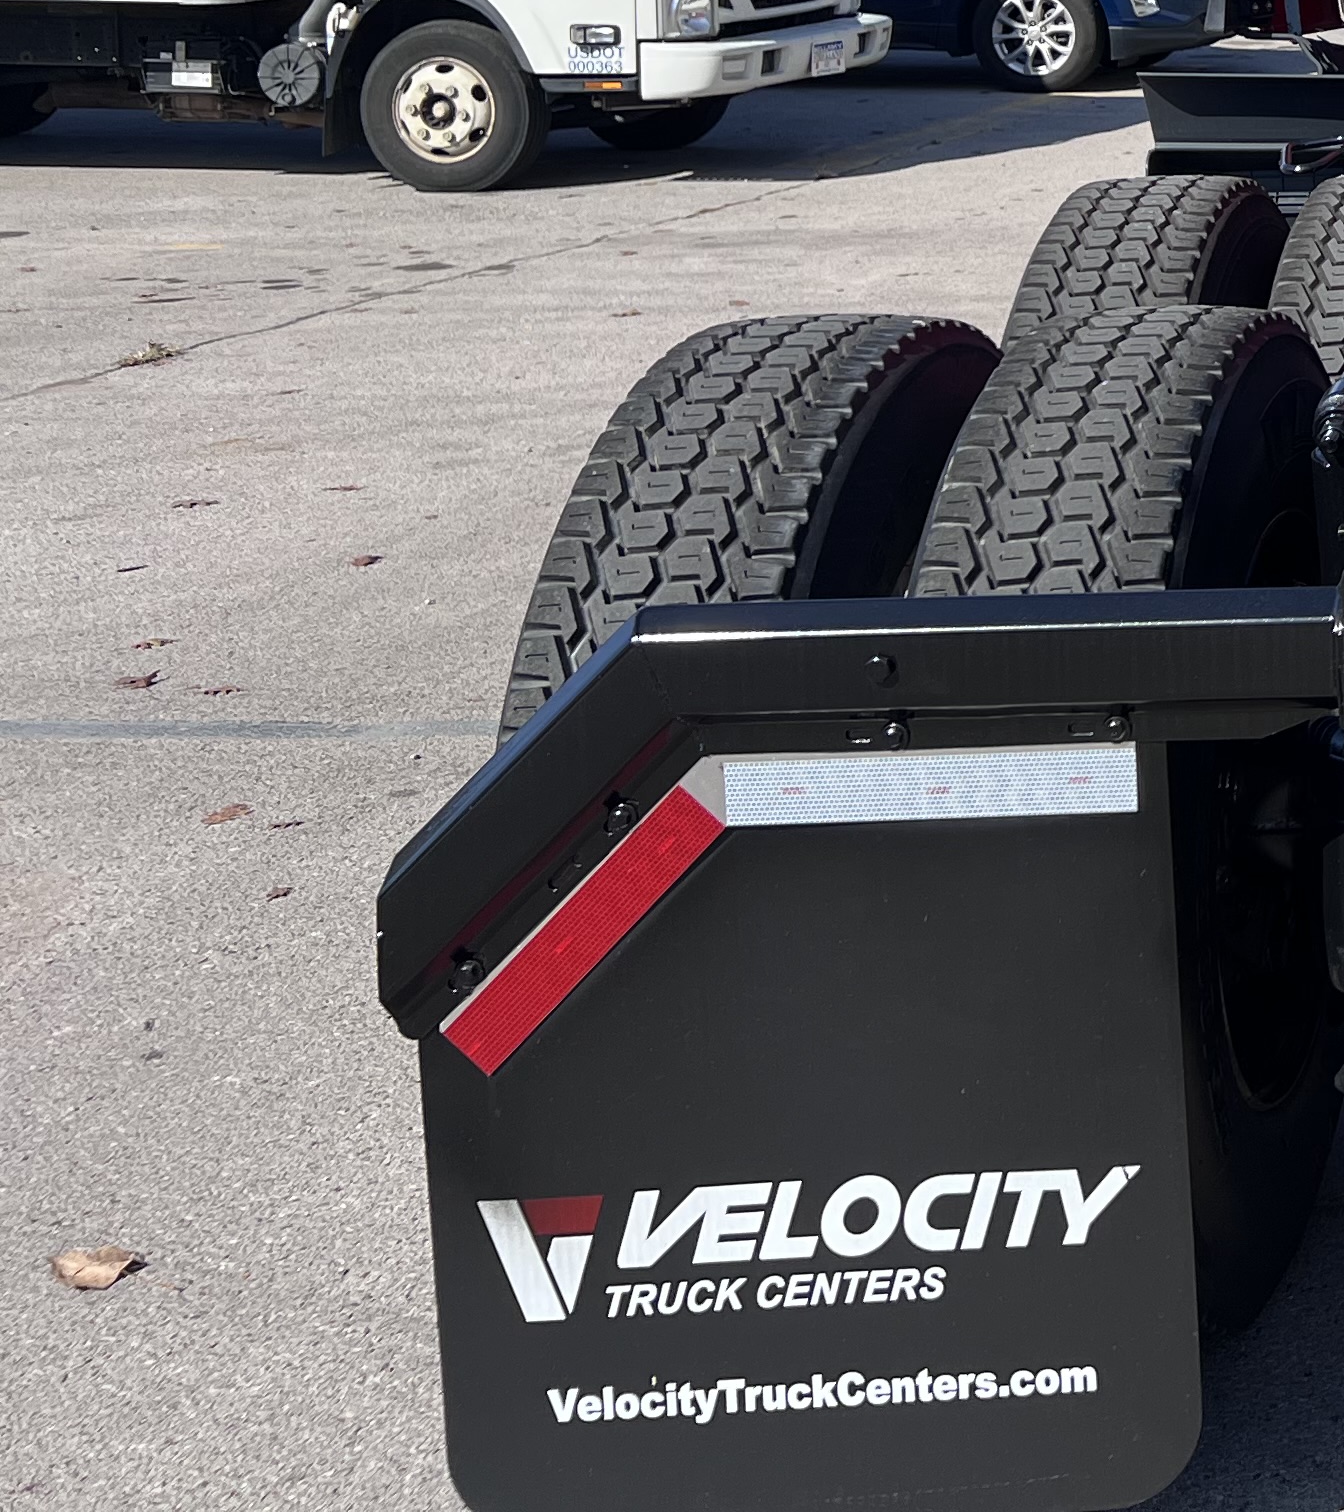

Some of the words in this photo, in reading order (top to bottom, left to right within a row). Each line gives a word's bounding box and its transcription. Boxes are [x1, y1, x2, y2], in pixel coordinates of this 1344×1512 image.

[568, 60, 623, 74] 000363
[617, 1164, 1141, 1269] VELOCITY
[605, 1278, 747, 1318] TRUCK
[757, 1266, 947, 1310] CENTERS
[546, 1365, 1098, 1424] VelocityTruckCenters.com
